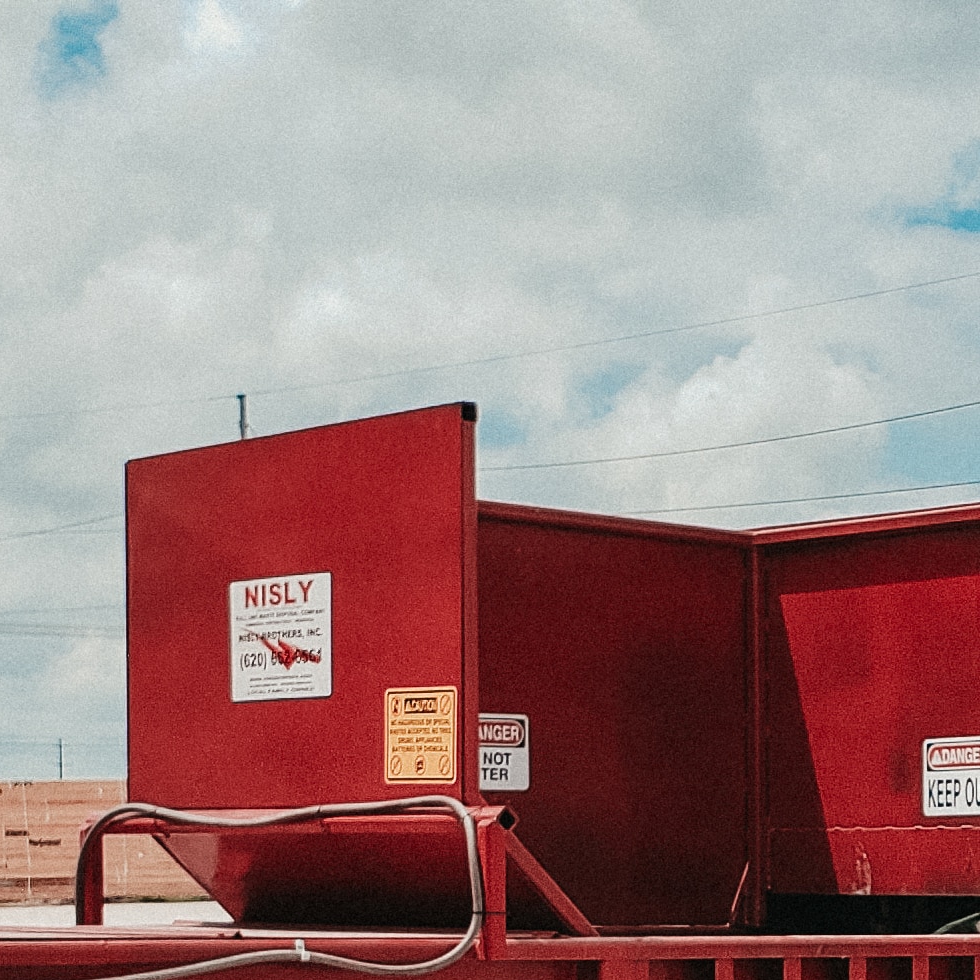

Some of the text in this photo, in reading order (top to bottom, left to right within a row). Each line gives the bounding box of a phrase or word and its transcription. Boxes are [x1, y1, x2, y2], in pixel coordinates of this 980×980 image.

[245, 580, 314, 608] NISLY
[240, 651, 267, 671] (620)
[483, 752, 512, 765] NOT
[481, 768, 509, 780] TER
[928, 779, 961, 808] KEEP
